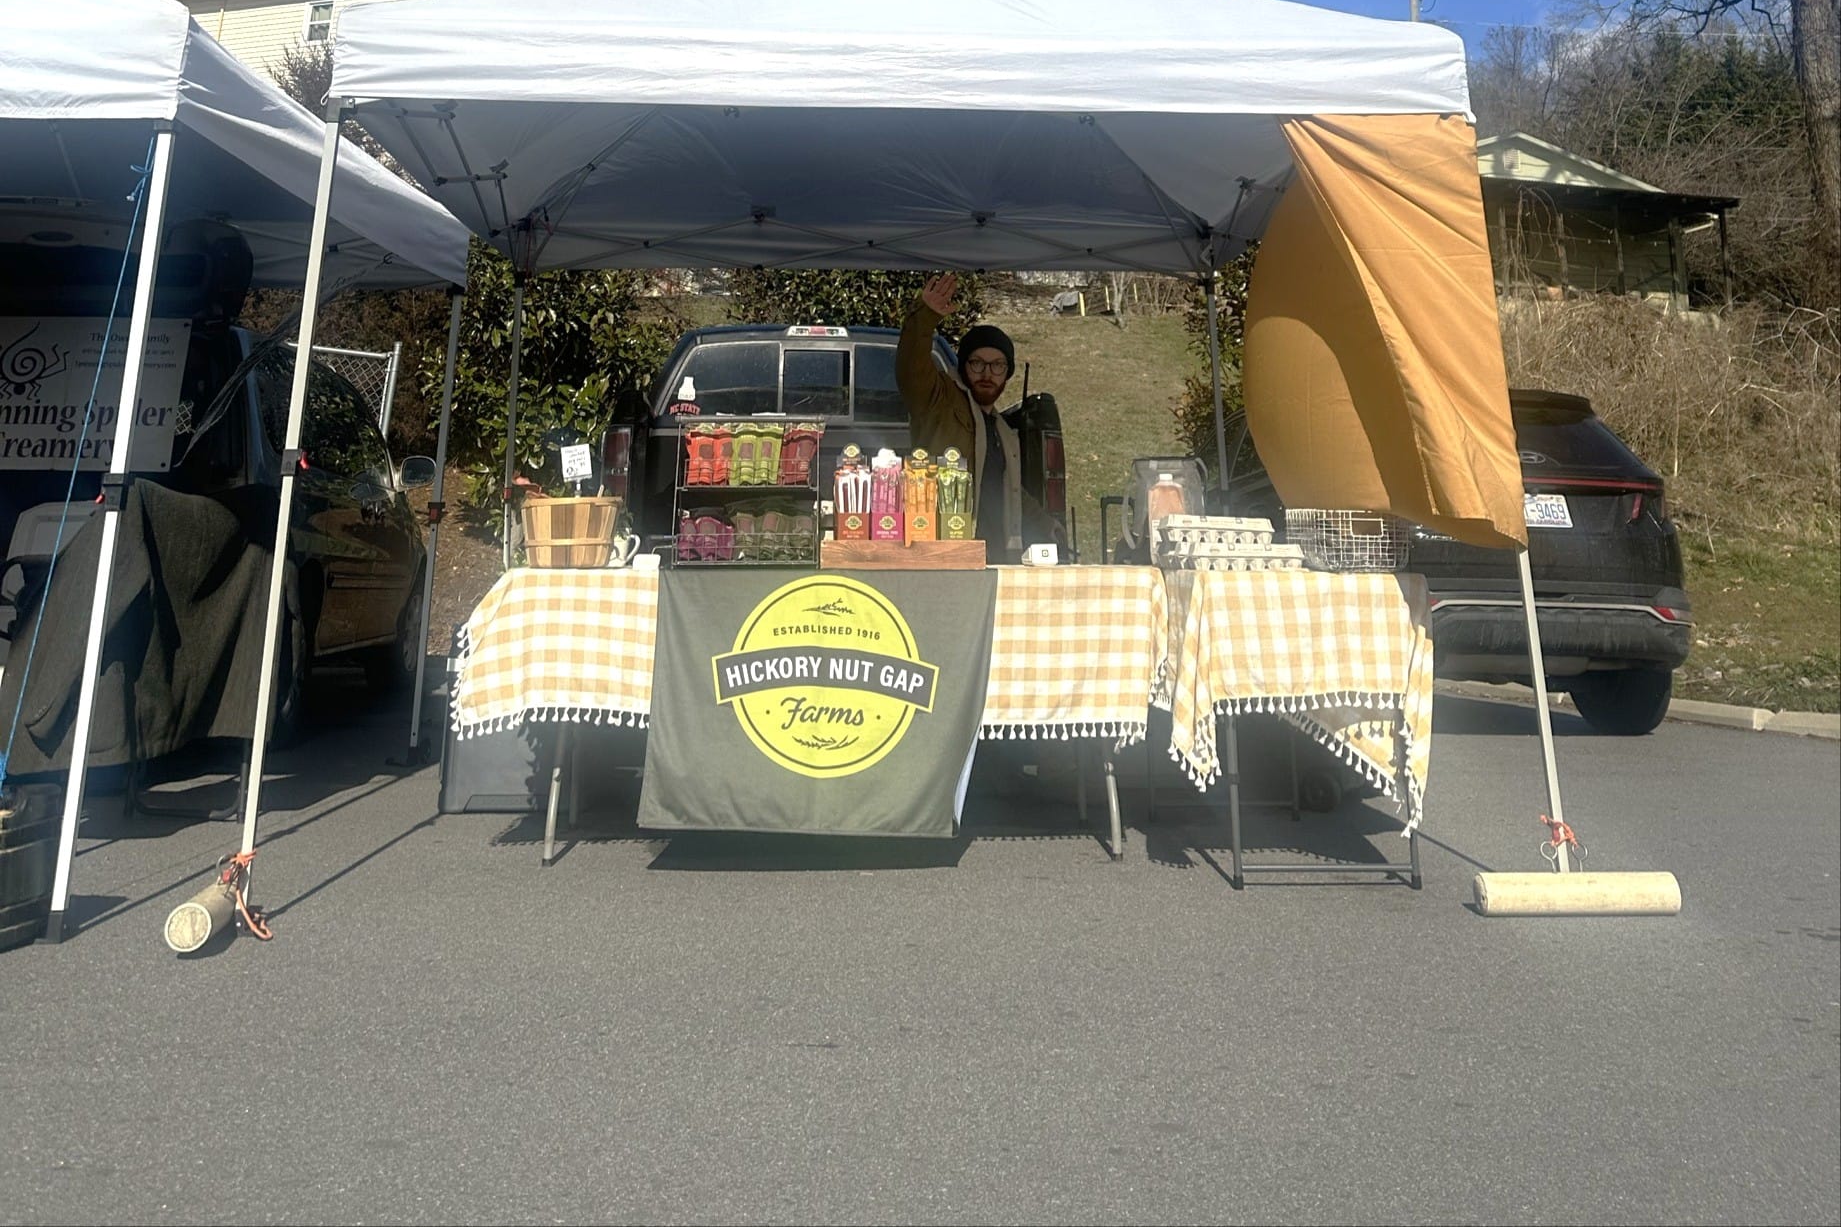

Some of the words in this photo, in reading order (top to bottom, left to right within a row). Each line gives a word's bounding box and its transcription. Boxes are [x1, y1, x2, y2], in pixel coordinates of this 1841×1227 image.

[82, 398, 173, 432] Sper
[0, 431, 114, 466] reamery
[773, 624, 853, 637] ESTABLISHED
[857, 628, 881, 640] 1916
[725, 656, 822, 689] HICKORY
[829, 657, 874, 683] NUT
[879, 665, 925, 695] GAP
[780, 696, 864, 730] Farms
